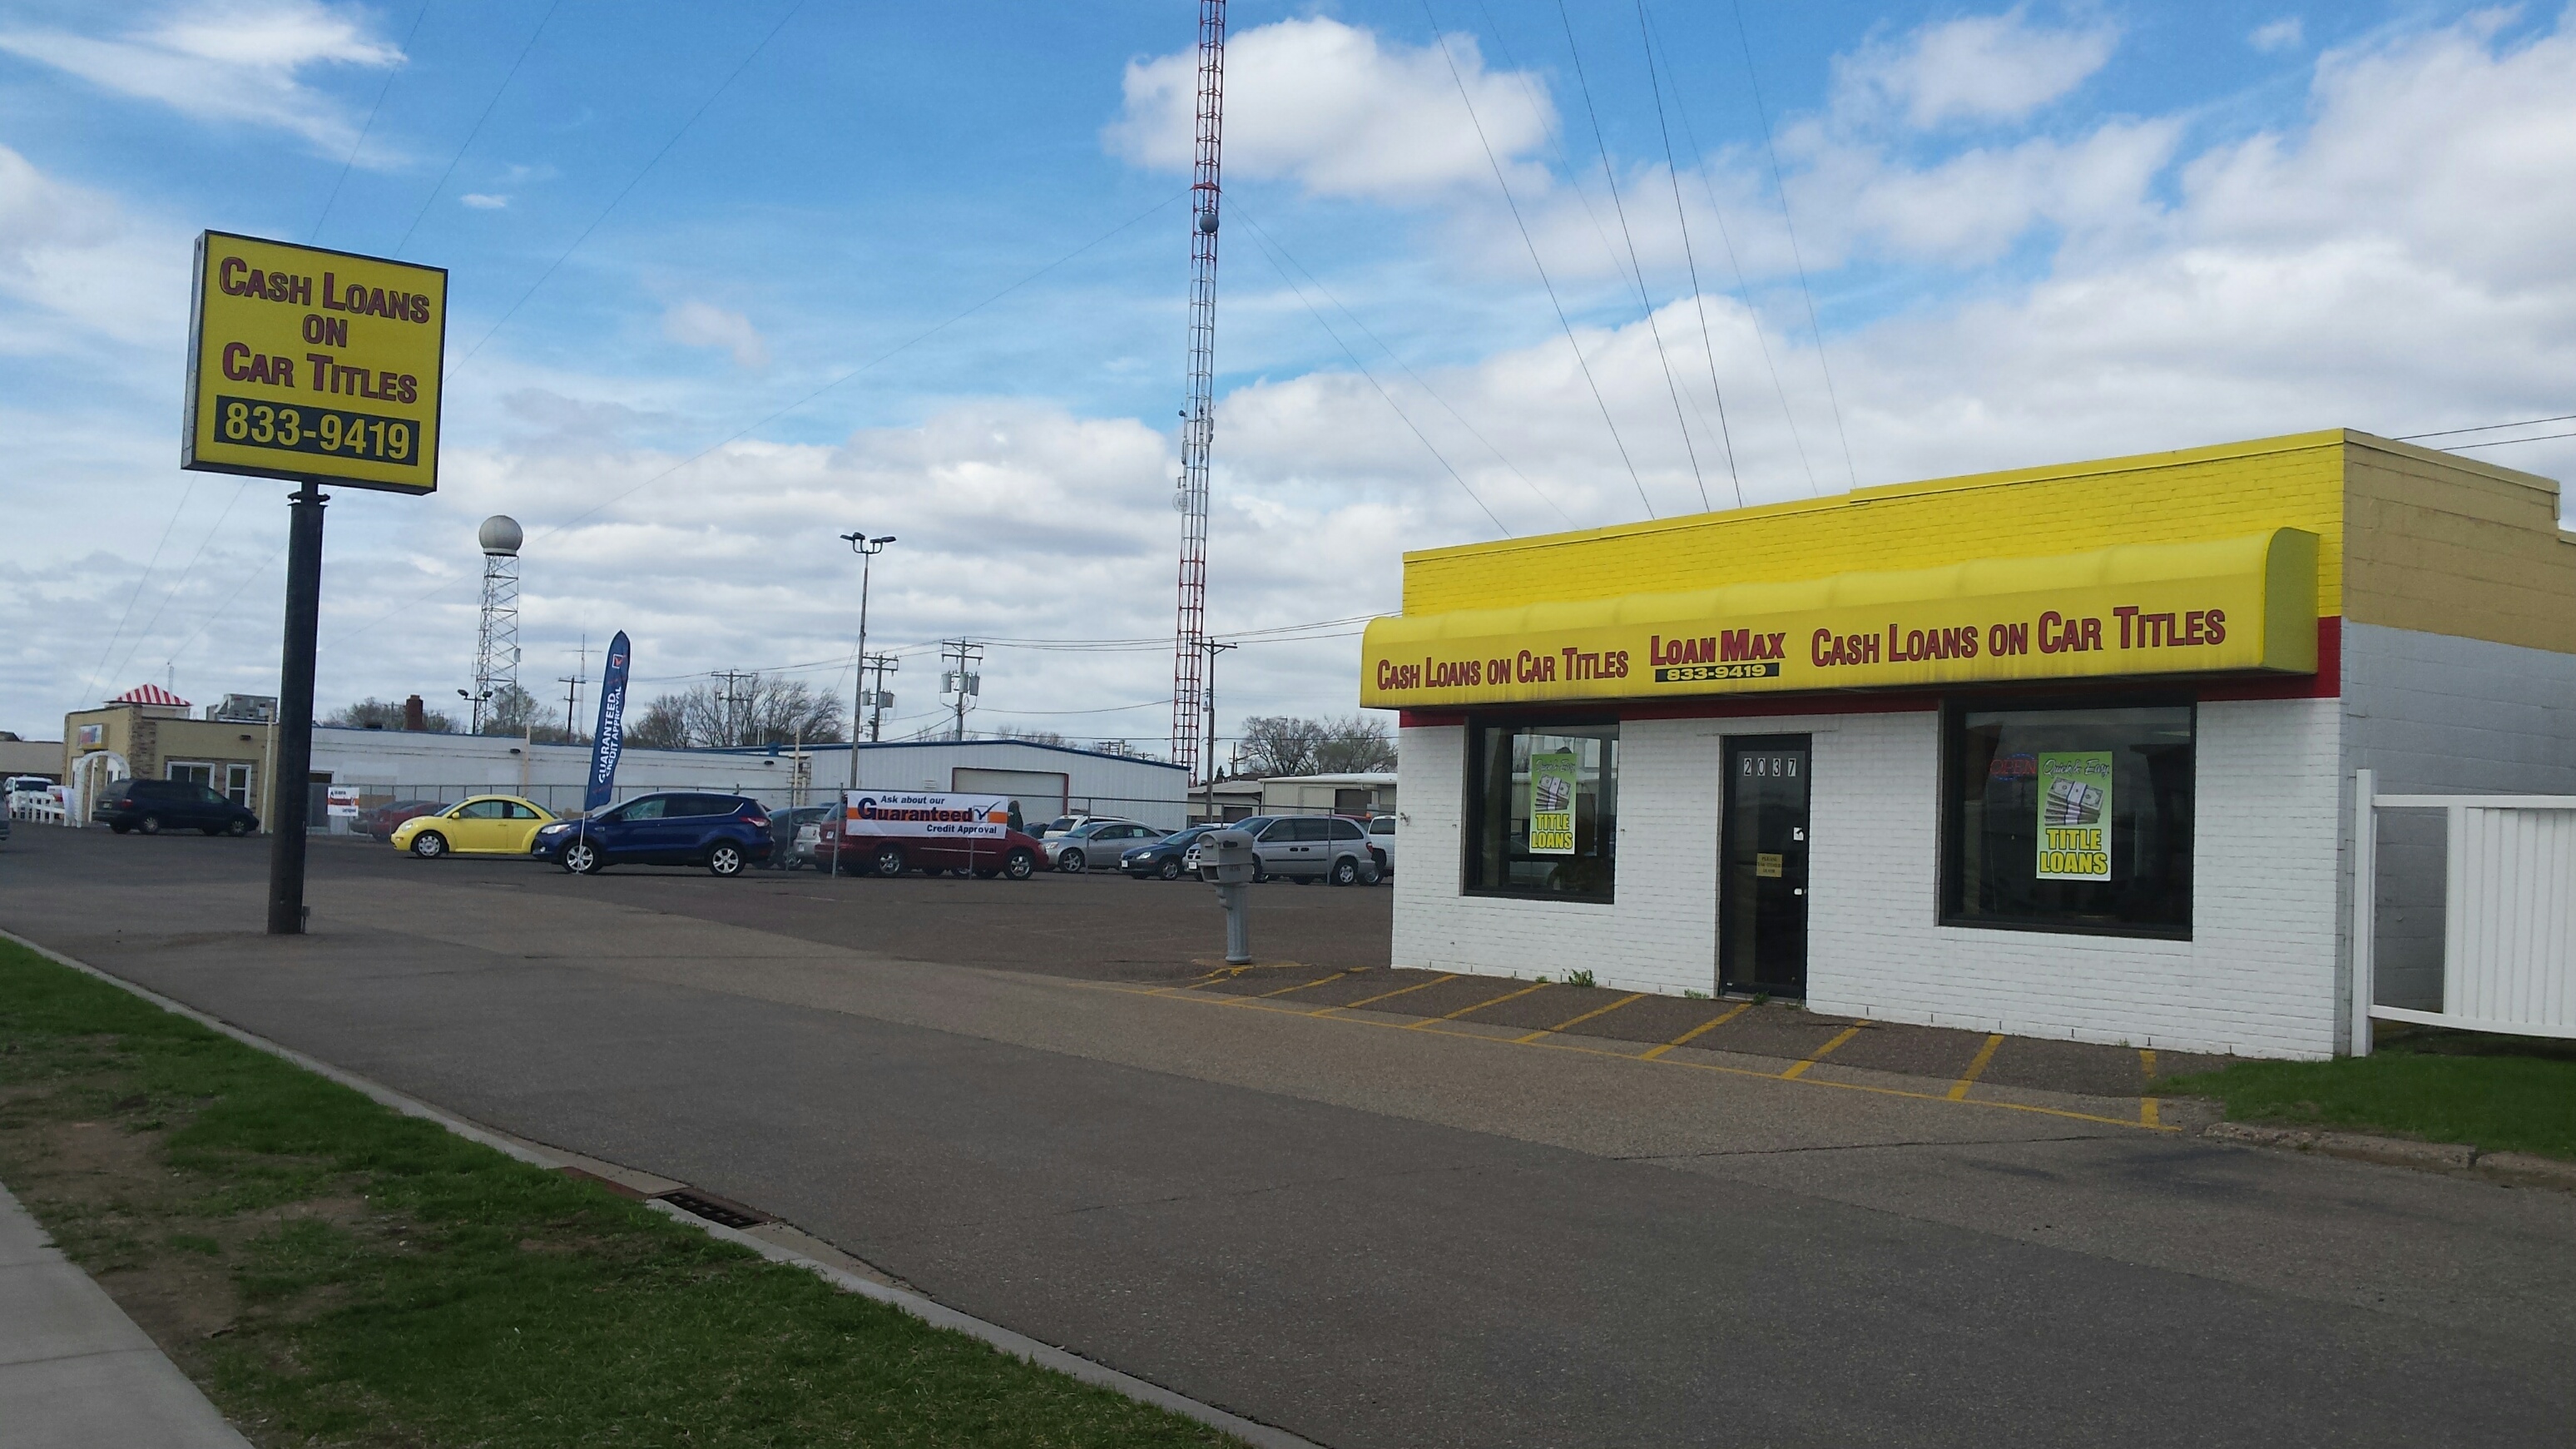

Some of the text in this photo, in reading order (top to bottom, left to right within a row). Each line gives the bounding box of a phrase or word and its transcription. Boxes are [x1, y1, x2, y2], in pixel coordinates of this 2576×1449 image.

[220, 256, 430, 324] CASH LOANS
[302, 314, 348, 348] ON
[222, 342, 418, 404] CAR TITLES
[225, 402, 410, 459] 833-9419
[1811, 606, 2226, 667] CASH LOANS ON CAR TITLES
[1377, 647, 1629, 691] CASH LOANS ON CAR TITLES
[1667, 664, 1766, 681] 833-9419
[598, 692, 616, 784] GUARANTEED
[1745, 759, 1796, 776] 2037
[1989, 759, 2038, 775] OPEN
[2043, 759, 2072, 777] Quick
[2085, 758, 2110, 779] Easy
[857, 797, 973, 822] Guaranteed
[880, 795, 945, 805] Ask about our
[926, 824, 997, 835] Credit Approval
[1535, 813, 1570, 831] TITLE
[1532, 831, 1573, 849] LOANS
[2046, 828, 2102, 851] TITLE
[2040, 851, 2108, 874] LOANS
